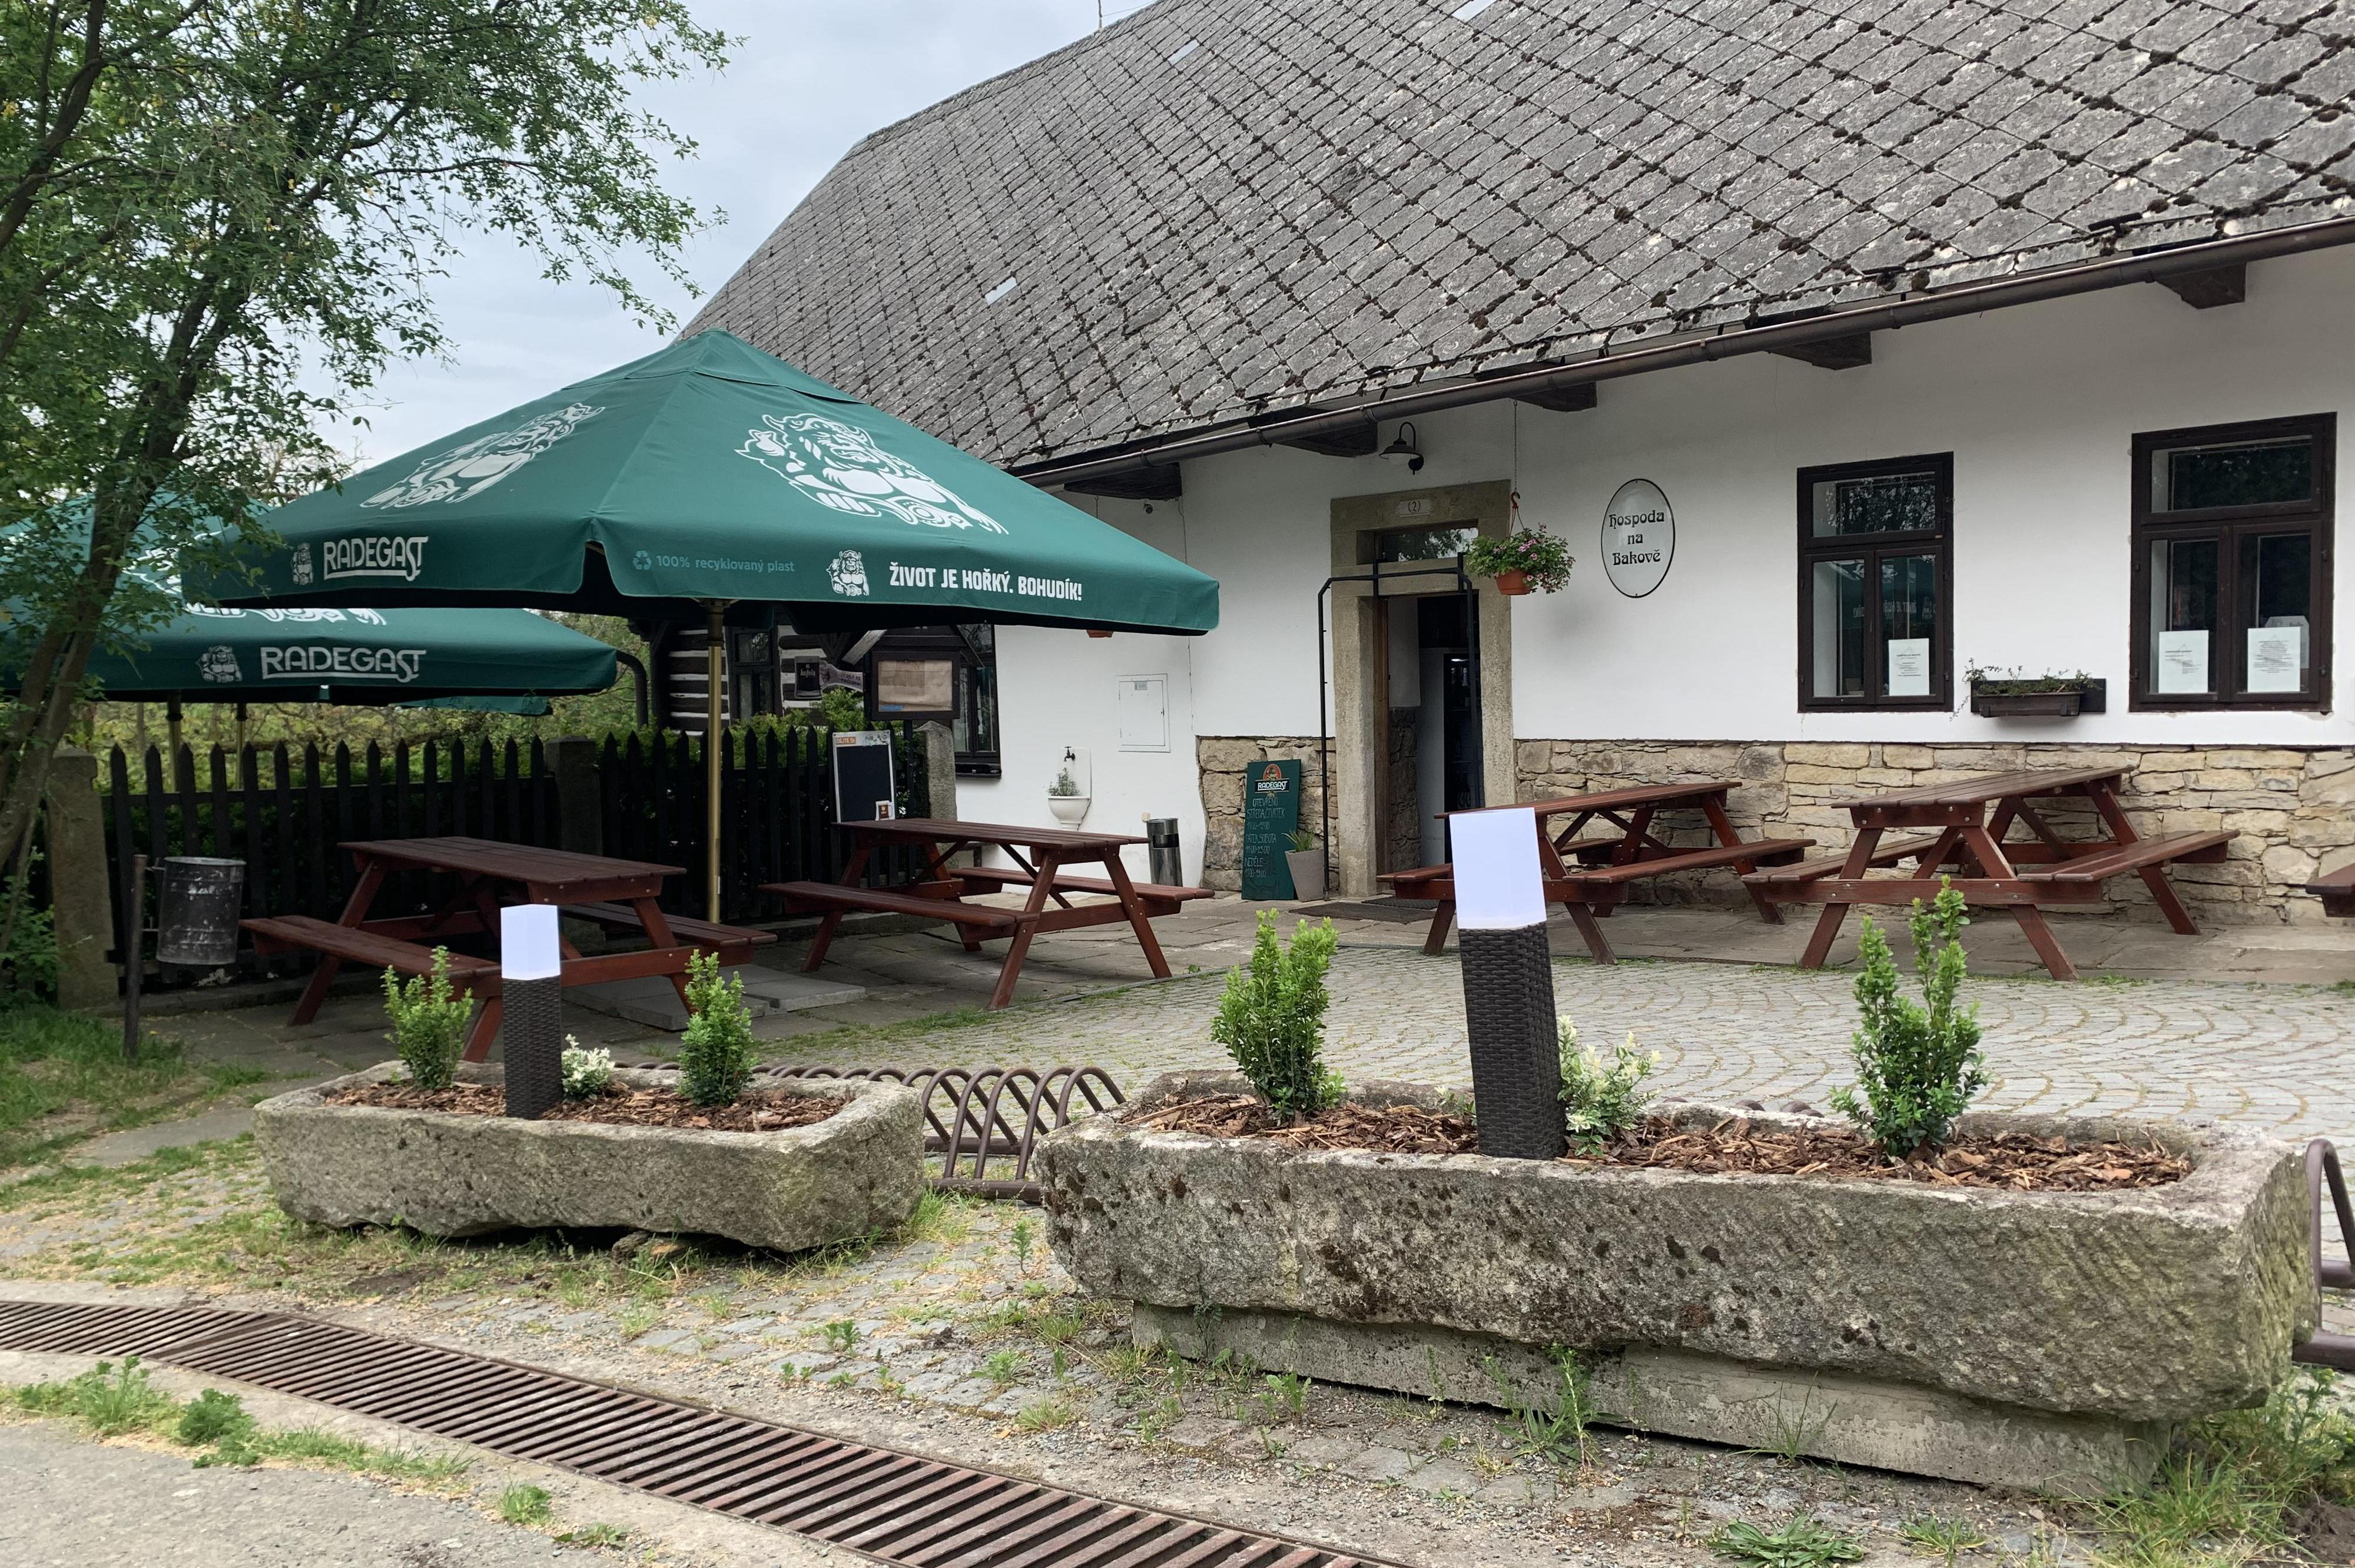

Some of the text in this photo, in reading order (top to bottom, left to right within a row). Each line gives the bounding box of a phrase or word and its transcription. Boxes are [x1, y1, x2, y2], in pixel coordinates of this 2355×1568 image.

[1627, 534, 1643, 545] na
[324, 535, 429, 582] RADEGAST
[656, 555, 795, 573] 100% recyklovaný plast
[1612, 549, 1661, 565] Bakově
[890, 562, 1083, 601] ŽIVOT JE HOŘKÝ. BOHUDÍK!
[260, 646, 427, 683] RADEGAST
[1258, 781, 1288, 791] RADEGAST
